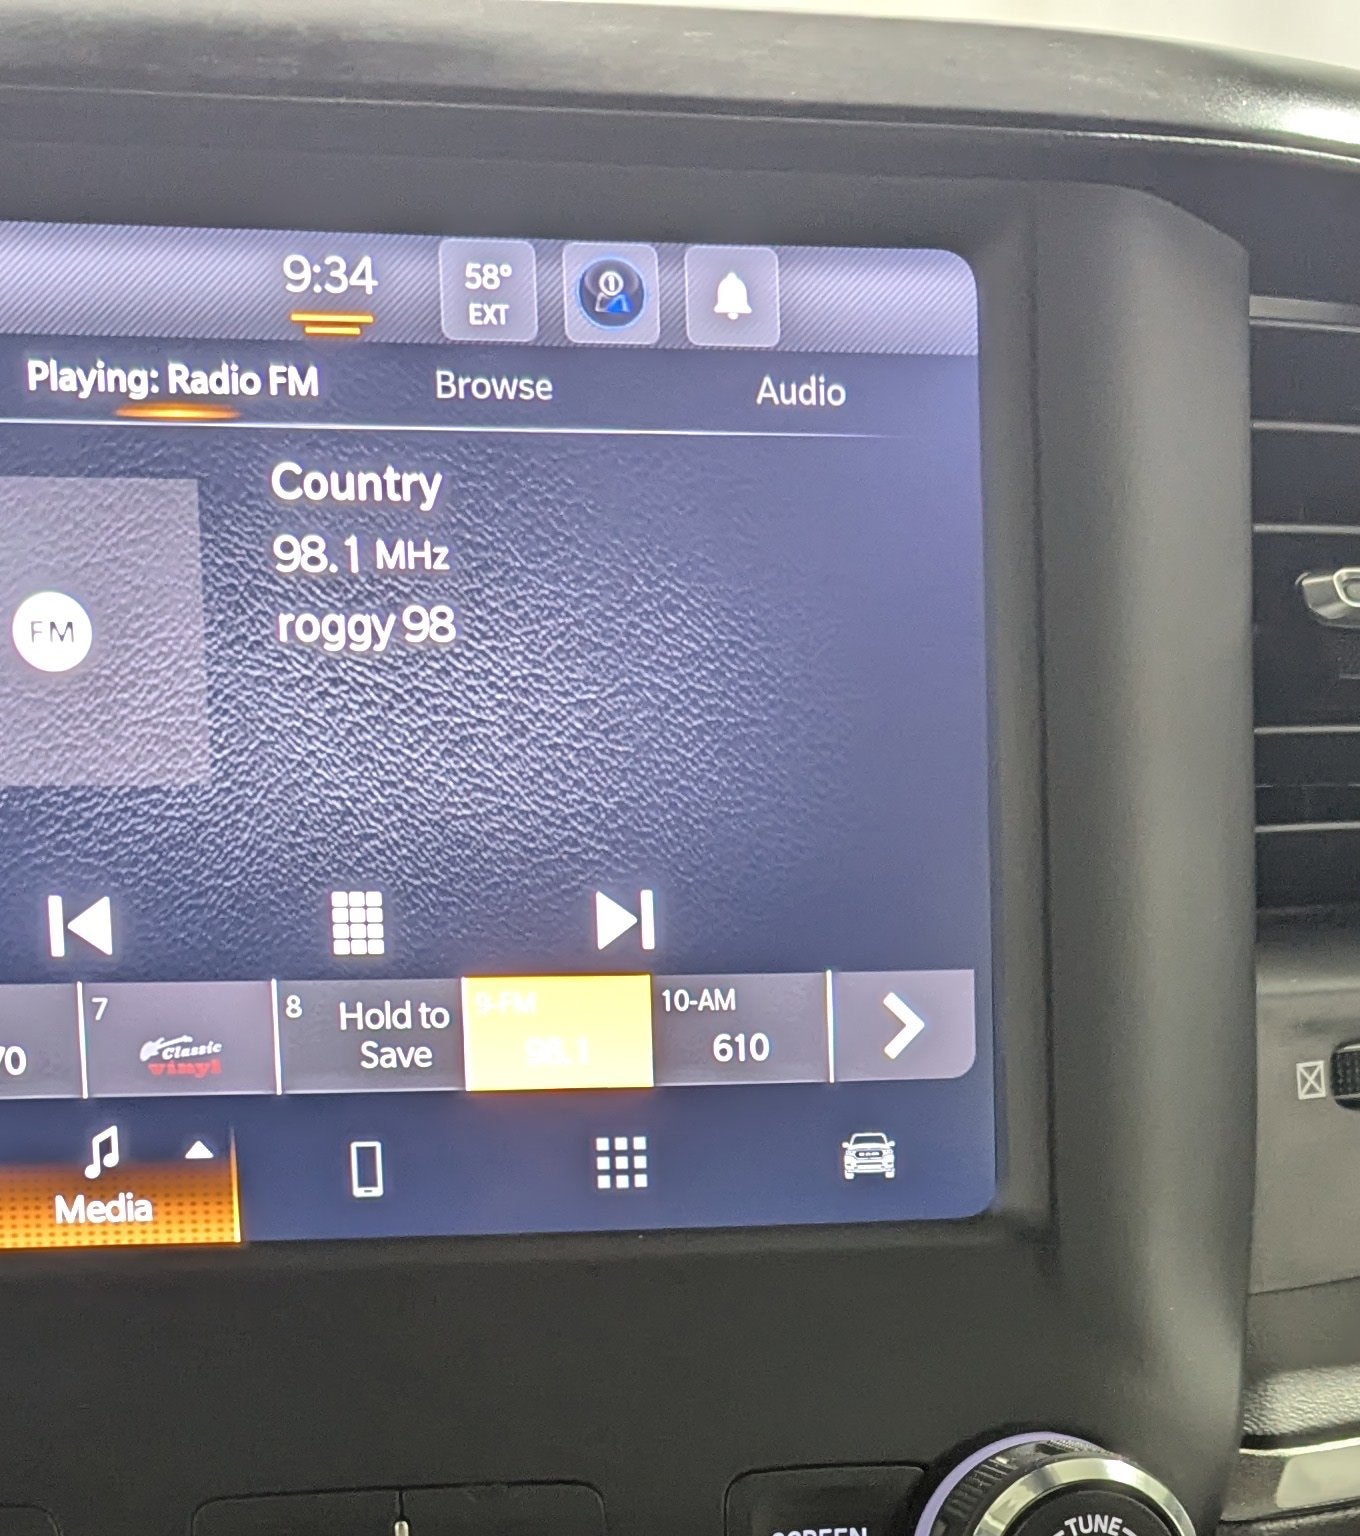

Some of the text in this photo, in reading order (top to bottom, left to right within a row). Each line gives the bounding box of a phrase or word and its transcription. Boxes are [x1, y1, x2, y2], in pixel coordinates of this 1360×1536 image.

[283, 254, 378, 296] 9:34
[464, 262, 513, 291] 58°
[469, 304, 510, 326] EXT
[27, 359, 319, 399] Playing: Radio FM
[436, 370, 553, 401] Browse
[756, 376, 846, 407] Audio
[271, 463, 442, 511] Country
[273, 535, 450, 574] 98.1 MHz
[29, 620, 75, 644] FM
[278, 605, 456, 651] roggy 98
[92, 998, 108, 1020] 7
[286, 996, 302, 1018] 8
[340, 1001, 450, 1031] Hold to
[662, 990, 736, 1012] 10-AM
[162, 1041, 222, 1060] Classic
[360, 1040, 433, 1070] Save
[713, 1034, 770, 1062] 610
[55, 1194, 153, 1225] Media
